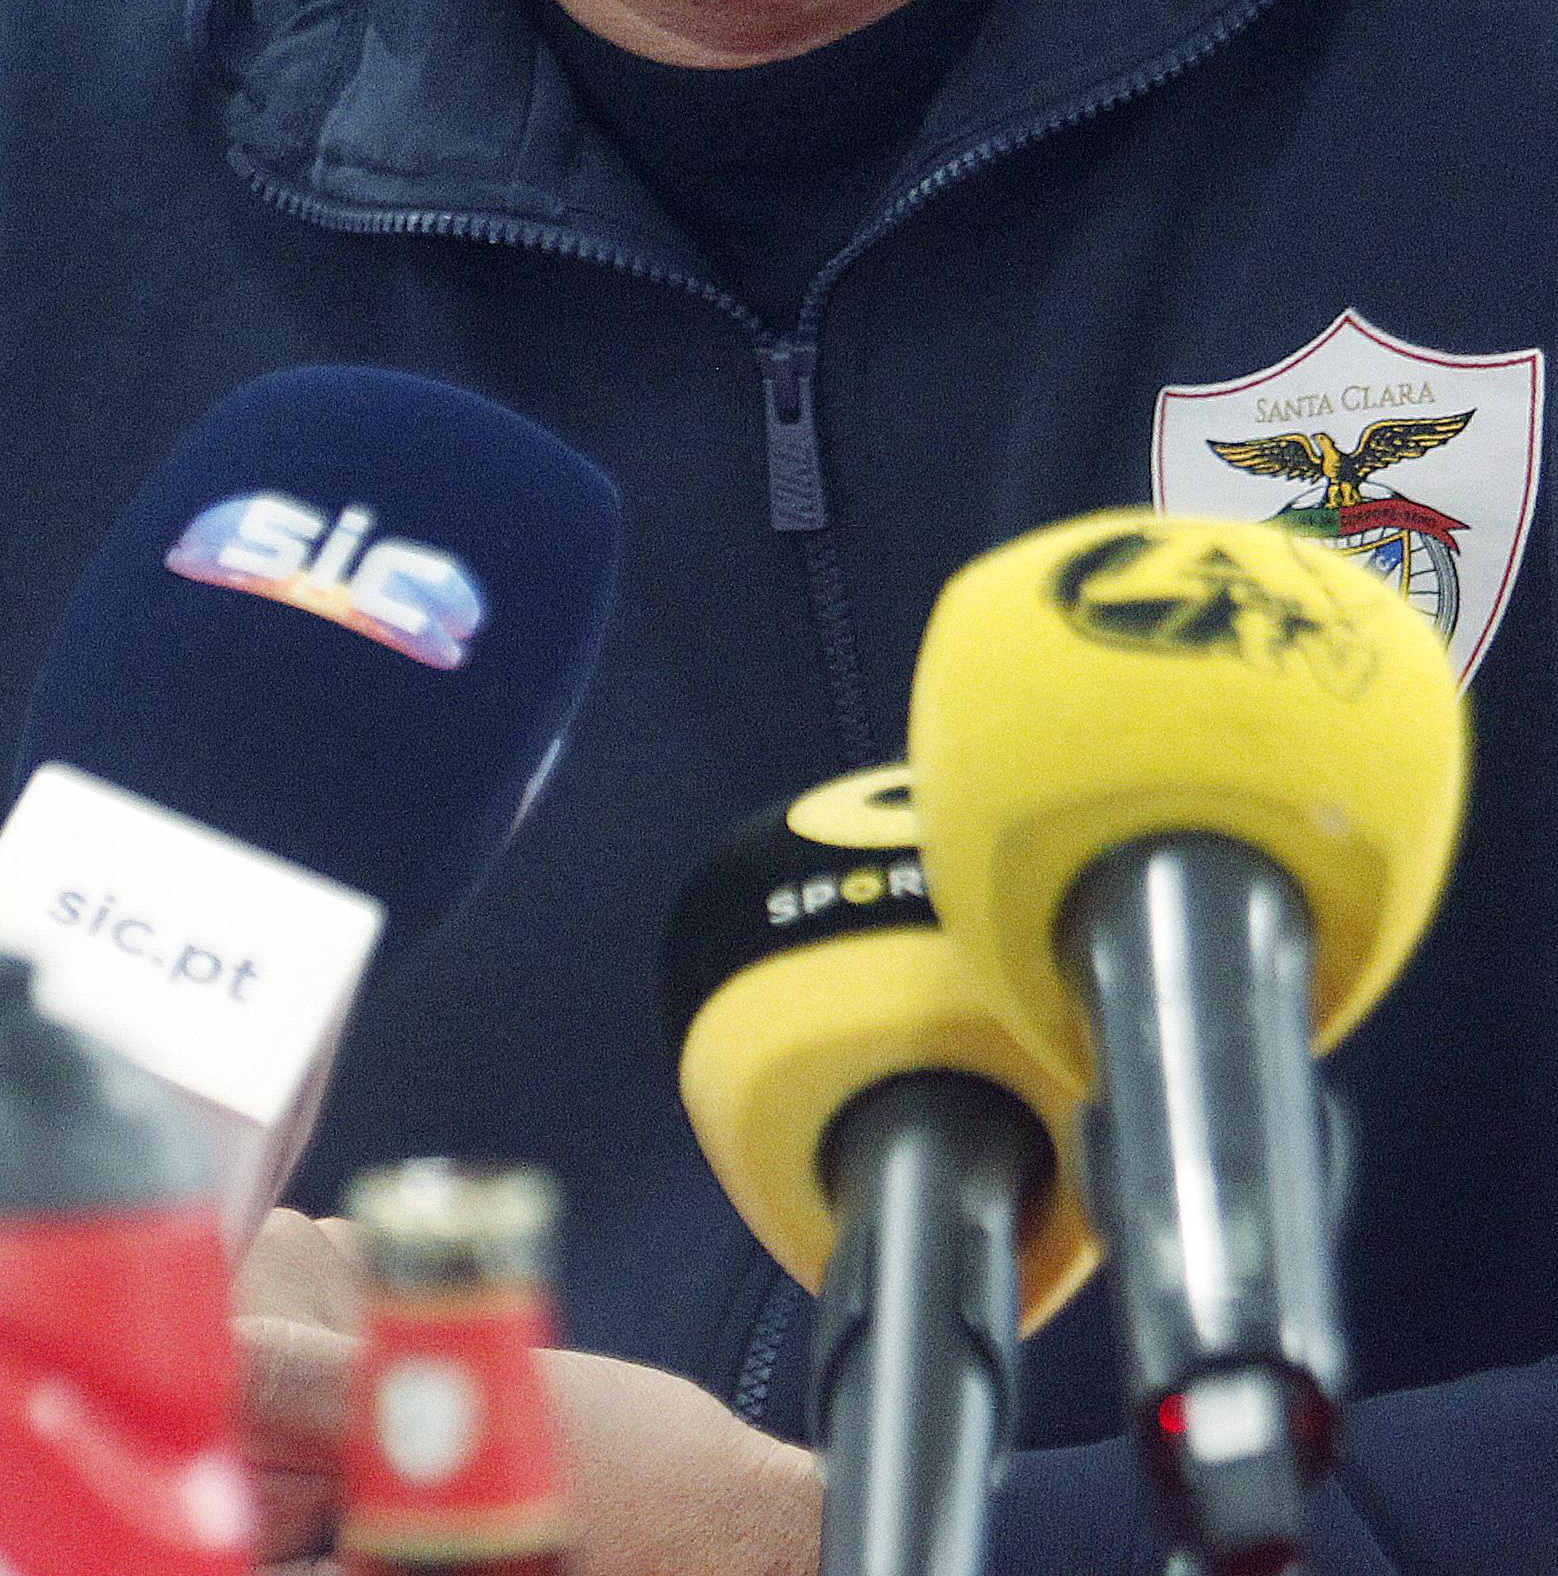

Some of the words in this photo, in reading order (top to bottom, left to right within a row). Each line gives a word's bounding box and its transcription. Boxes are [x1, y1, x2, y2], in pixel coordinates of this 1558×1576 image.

[1256, 394, 1334, 424] SANTA
[1341, 381, 1436, 412] CLARA
[217, 490, 455, 636] sic
[765, 862, 927, 924] SPOR
[48, 885, 258, 1003] sic.pt
